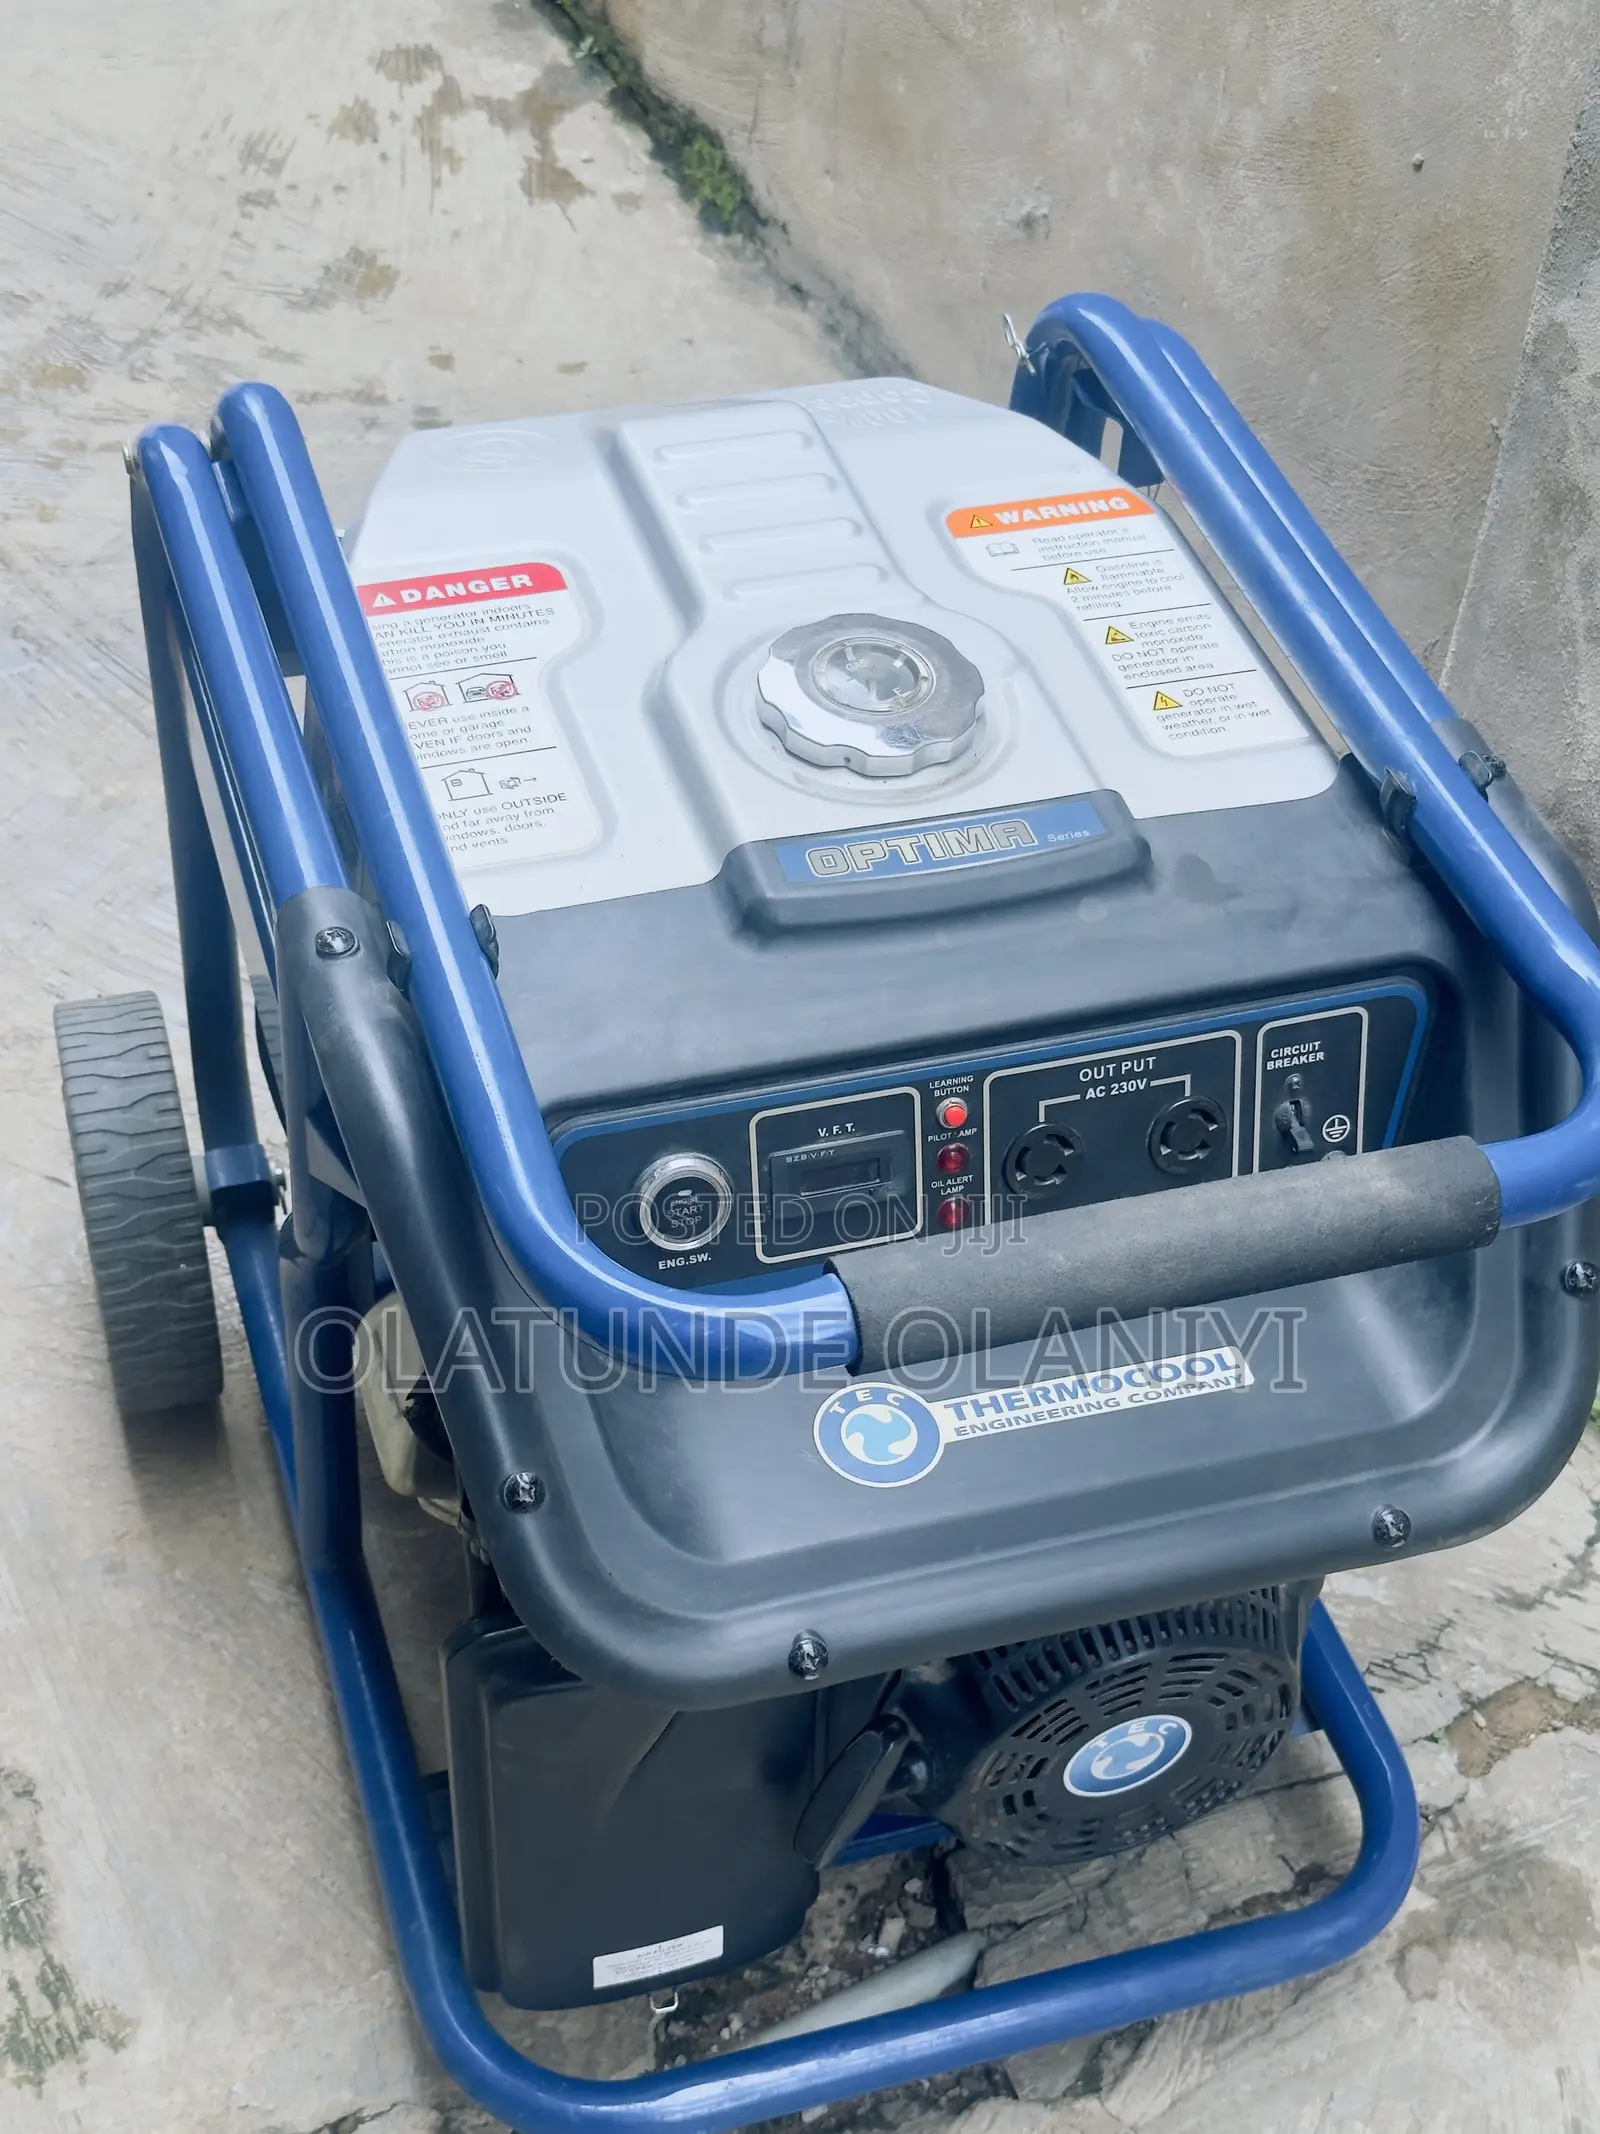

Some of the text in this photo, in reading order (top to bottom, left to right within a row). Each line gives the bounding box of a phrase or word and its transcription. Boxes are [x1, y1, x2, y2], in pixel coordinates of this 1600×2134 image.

[993, 496, 1130, 525] WARNING
[1038, 533, 1147, 553] instruction manual
[1042, 550, 1081, 561] before
[1095, 560, 1149, 573] Gasoline
[1101, 567, 1164, 581] flammable
[400, 573, 533, 603] DANGER
[1067, 584, 1099, 594] Allow
[1102, 579, 1142, 590] engine
[1160, 573, 1185, 583] cool
[1082, 590, 1130, 602] minutes
[1133, 584, 1172, 595] before
[376, 607, 555, 640] AN KILL YOU IN MINUTES
[415, 611, 477, 626] generator
[483, 603, 531, 616] indoors
[1129, 613, 1211, 630] Engine emits
[378, 618, 550, 648] enerator exhaust contains
[1135, 623, 1211, 639] toxic carbon
[380, 636, 485, 657] arbon monoxide
[1141, 634, 1203, 648] monoxide
[381, 657, 402, 666] his
[434, 647, 478, 659] poison
[483, 643, 506, 653] you
[1112, 642, 1219, 662] DO NOT operate
[426, 660, 450, 668] see
[1118, 657, 1178, 672] generator
[1124, 662, 1215, 681] enclosed area
[1182, 683, 1235, 697] DO NOT
[1189, 694, 1237, 707] operate
[405, 716, 449, 731] EVER
[452, 713, 476, 723] use
[480, 706, 518, 719] inside
[1157, 707, 1217, 722] generator
[1236, 701, 1258, 709] wet
[1249, 709, 1272, 718] wet
[409, 730, 438, 740] ome
[459, 720, 505, 734] garage
[415, 725, 532, 750] VEN IF doors and
[416, 746, 467, 760] indows
[471, 742, 491, 752] are
[473, 805, 498, 815] use
[501, 792, 568, 810] OUTSIDE
[443, 807, 555, 831] nd far away from
[450, 842, 468, 852] nd
[805, 817, 1090, 878] OPTIMA Series
[1269, 1041, 1322, 1060] CIRCUIT
[1078, 1057, 1157, 1083] OUT PUT
[1266, 1051, 1325, 1071] BREAKER
[929, 1075, 974, 1089] LEARNING
[934, 1085, 970, 1097] BUTTON
[1085, 1077, 1148, 1101] AC 230V
[927, 1132, 952, 1143] PILOT
[931, 1174, 974, 1189] OIL ALERT
[940, 1185, 965, 1196] LAMP
[667, 1203, 705, 1218] START
[670, 1215, 703, 1229] STOP
[944, 1352, 1240, 1423] THERMOCOOL
[953, 1372, 1245, 1438] ENGINEERING COMPANY
